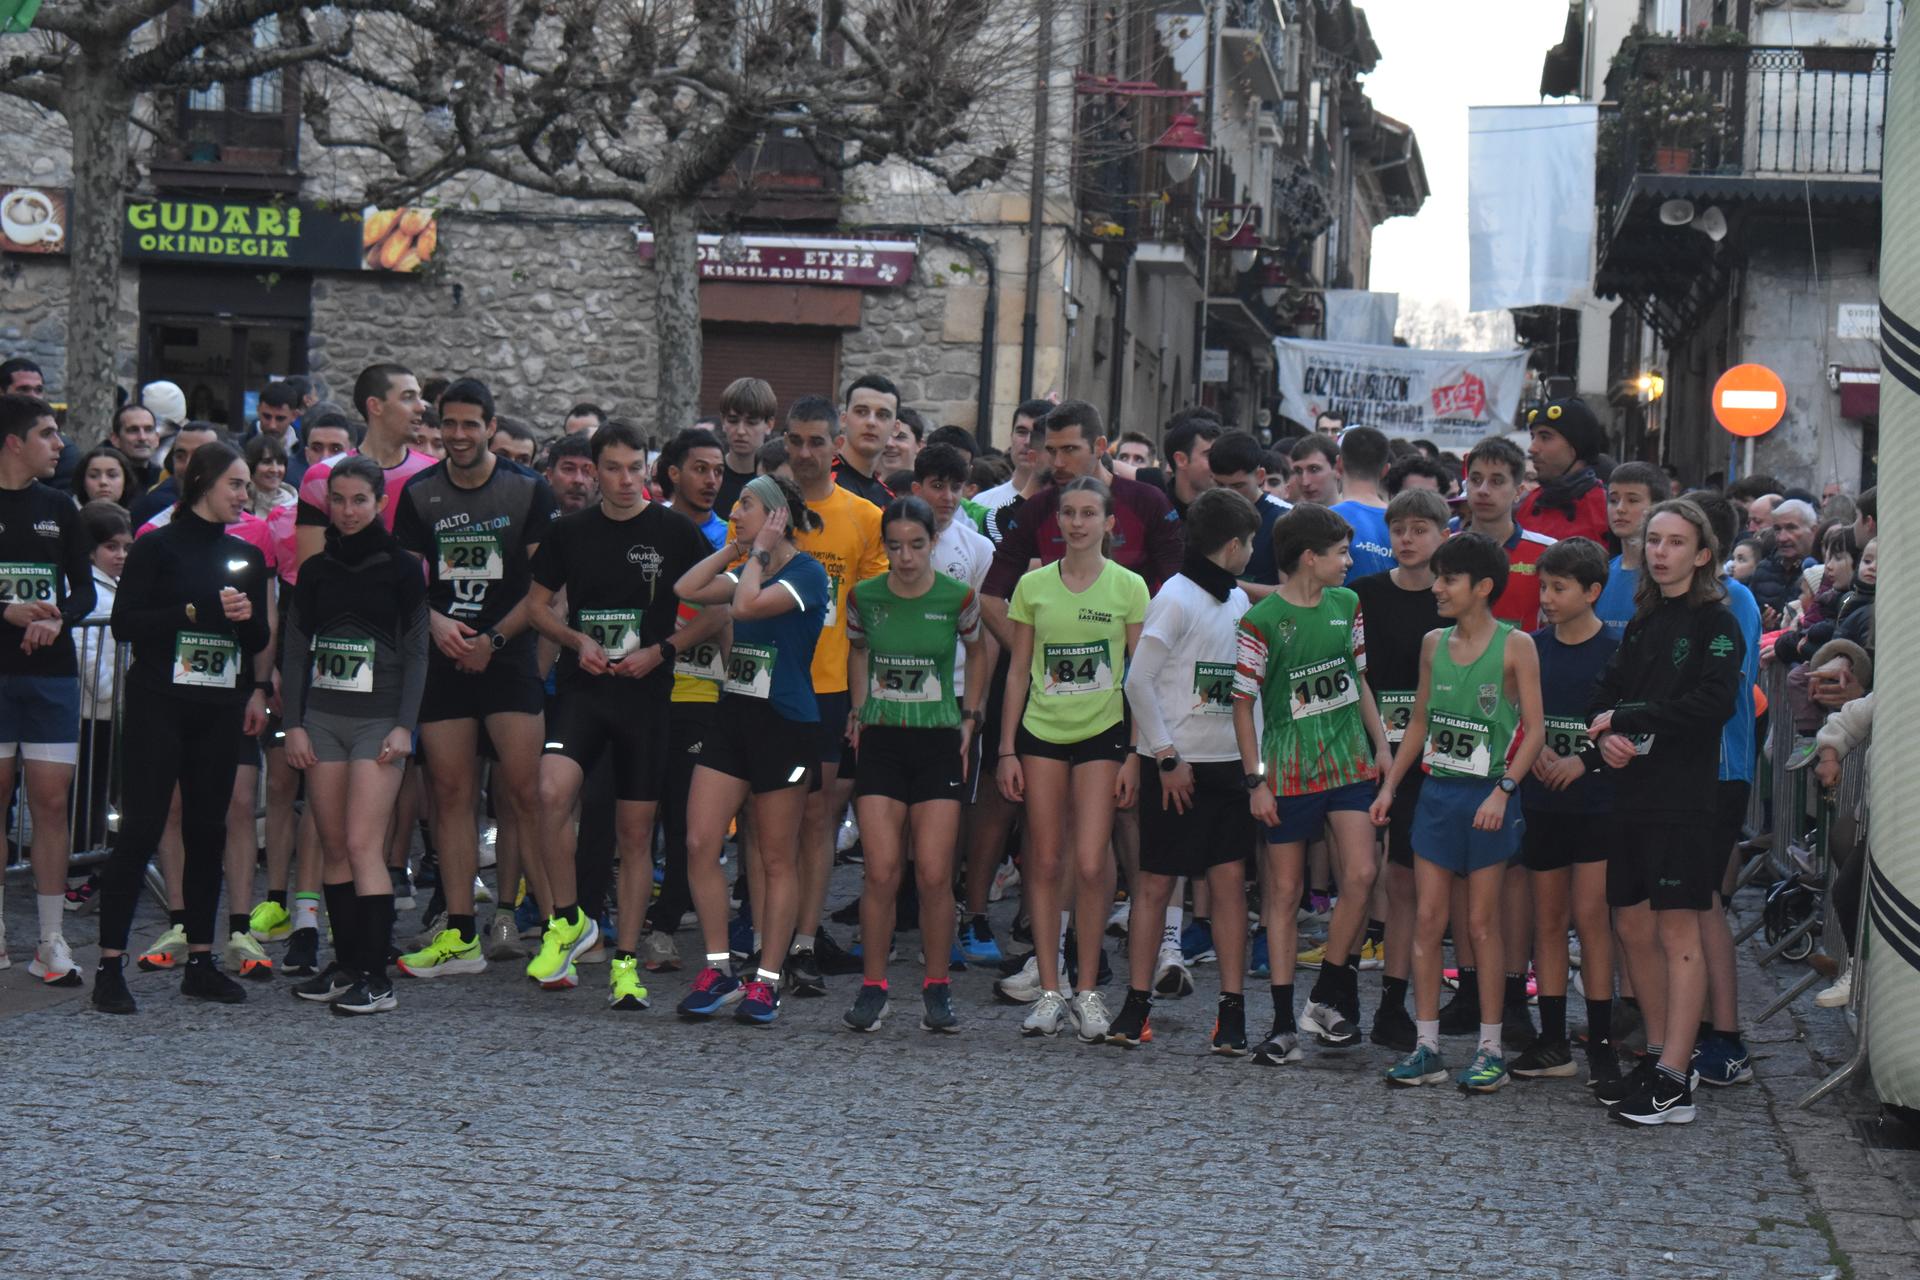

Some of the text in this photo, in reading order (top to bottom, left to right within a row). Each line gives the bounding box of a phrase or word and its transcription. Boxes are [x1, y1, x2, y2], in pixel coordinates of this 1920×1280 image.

[128, 201, 301, 238] GUDARI
[139, 233, 289, 258] OKINDEGIA
[804, 250, 875, 269] ETXEA
[703, 264, 844, 281] KIRKILADENDA
[456, 535, 497, 543] SILBESTREA
[452, 546, 488, 568] 28
[11, 567, 52, 575] SILBESTREA
[0, 579, 51, 600] 208
[581, 613, 636, 621] SAN SILBESTREA
[181, 636, 235, 648] SAN SILBESTREA
[328, 641, 369, 653] SILBESTREA
[1047, 645, 1105, 656] SAN SILBESTREA
[191, 649, 226, 674] 58
[317, 652, 367, 679] 107
[875, 656, 935, 666] SAN SILBESTREA
[1057, 658, 1096, 683] 84
[1289, 656, 1346, 680] SAN SILBESTREA
[885, 669, 924, 691] 57
[1296, 669, 1350, 705] 106
[1382, 695, 1398, 703] SAN
[1432, 715, 1489, 733] SAN SILBESTREA
[1438, 730, 1475, 758] 95
